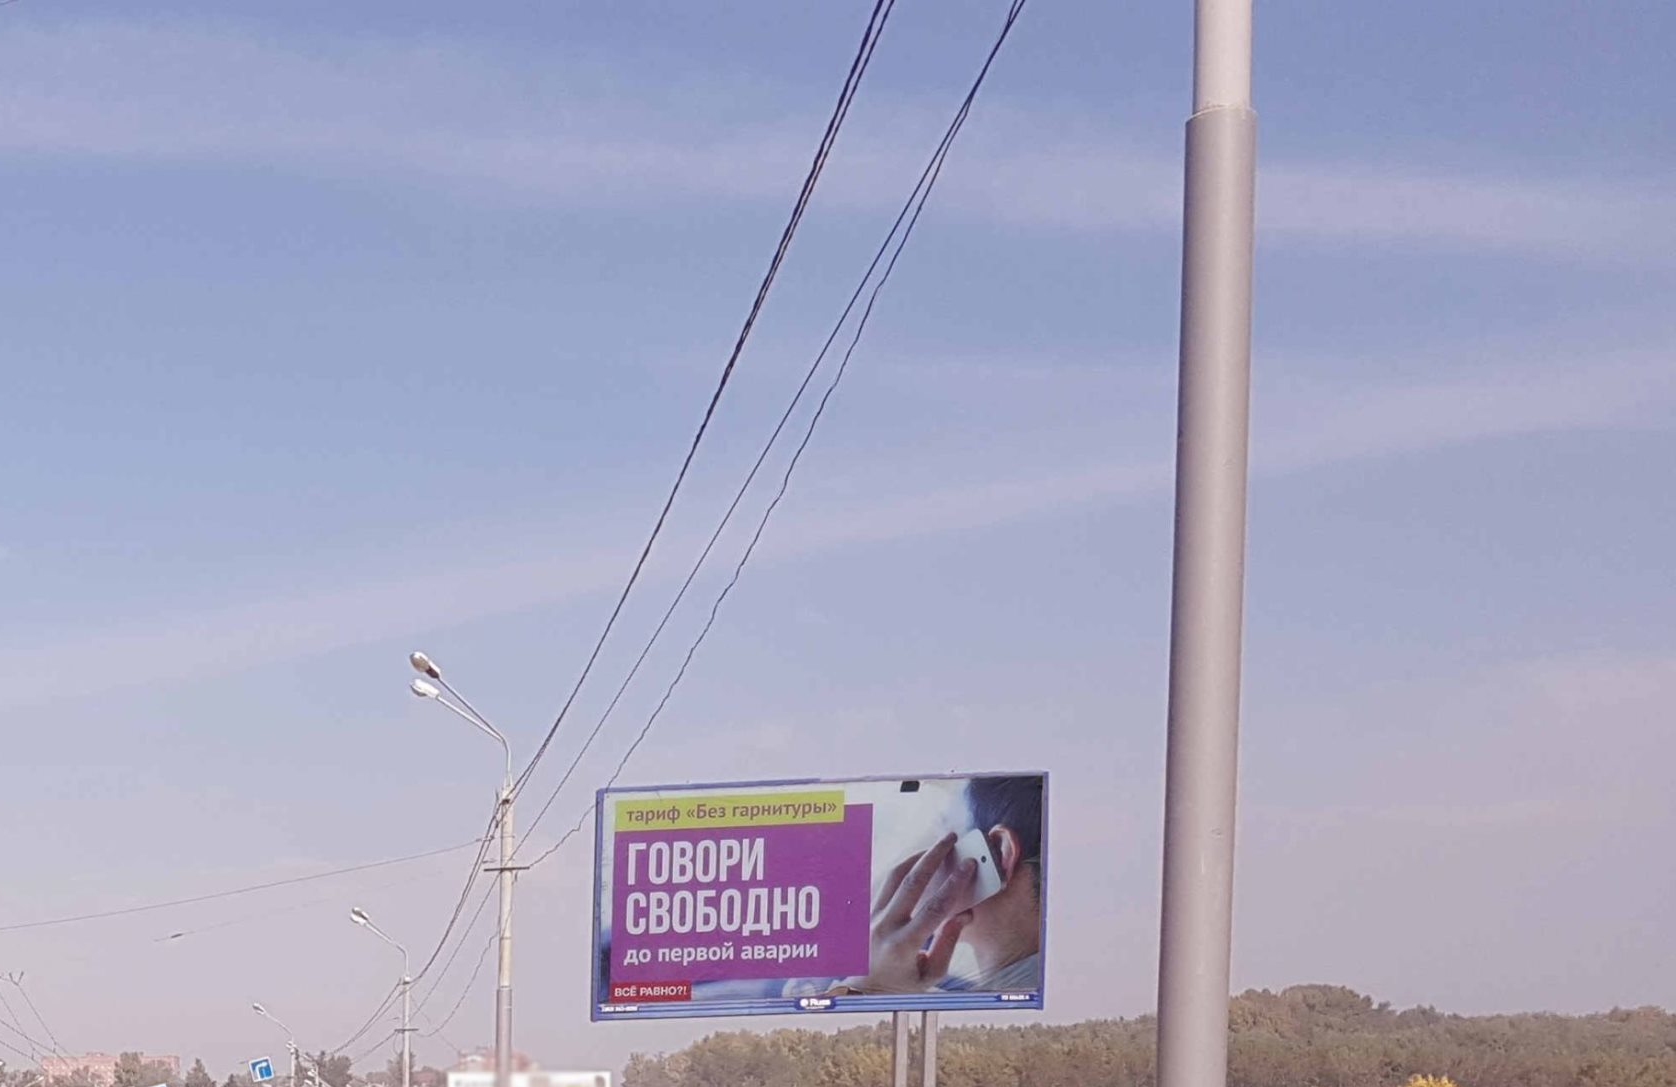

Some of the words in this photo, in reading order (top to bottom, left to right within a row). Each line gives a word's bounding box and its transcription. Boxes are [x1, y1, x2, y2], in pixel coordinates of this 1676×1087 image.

[626, 806, 681, 825] тариф
[686, 803, 726, 820] «Без
[732, 801, 837, 821] гарнитуры»
[627, 837, 765, 886] ГОВОРИ
[625, 885, 821, 937] СВОБОДНО
[623, 948, 651, 966] до
[658, 941, 734, 966] первой
[740, 943, 819, 964] аварии
[614, 985, 637, 997] ВСЁ
[639, 985, 687, 996] РАВНО?!
